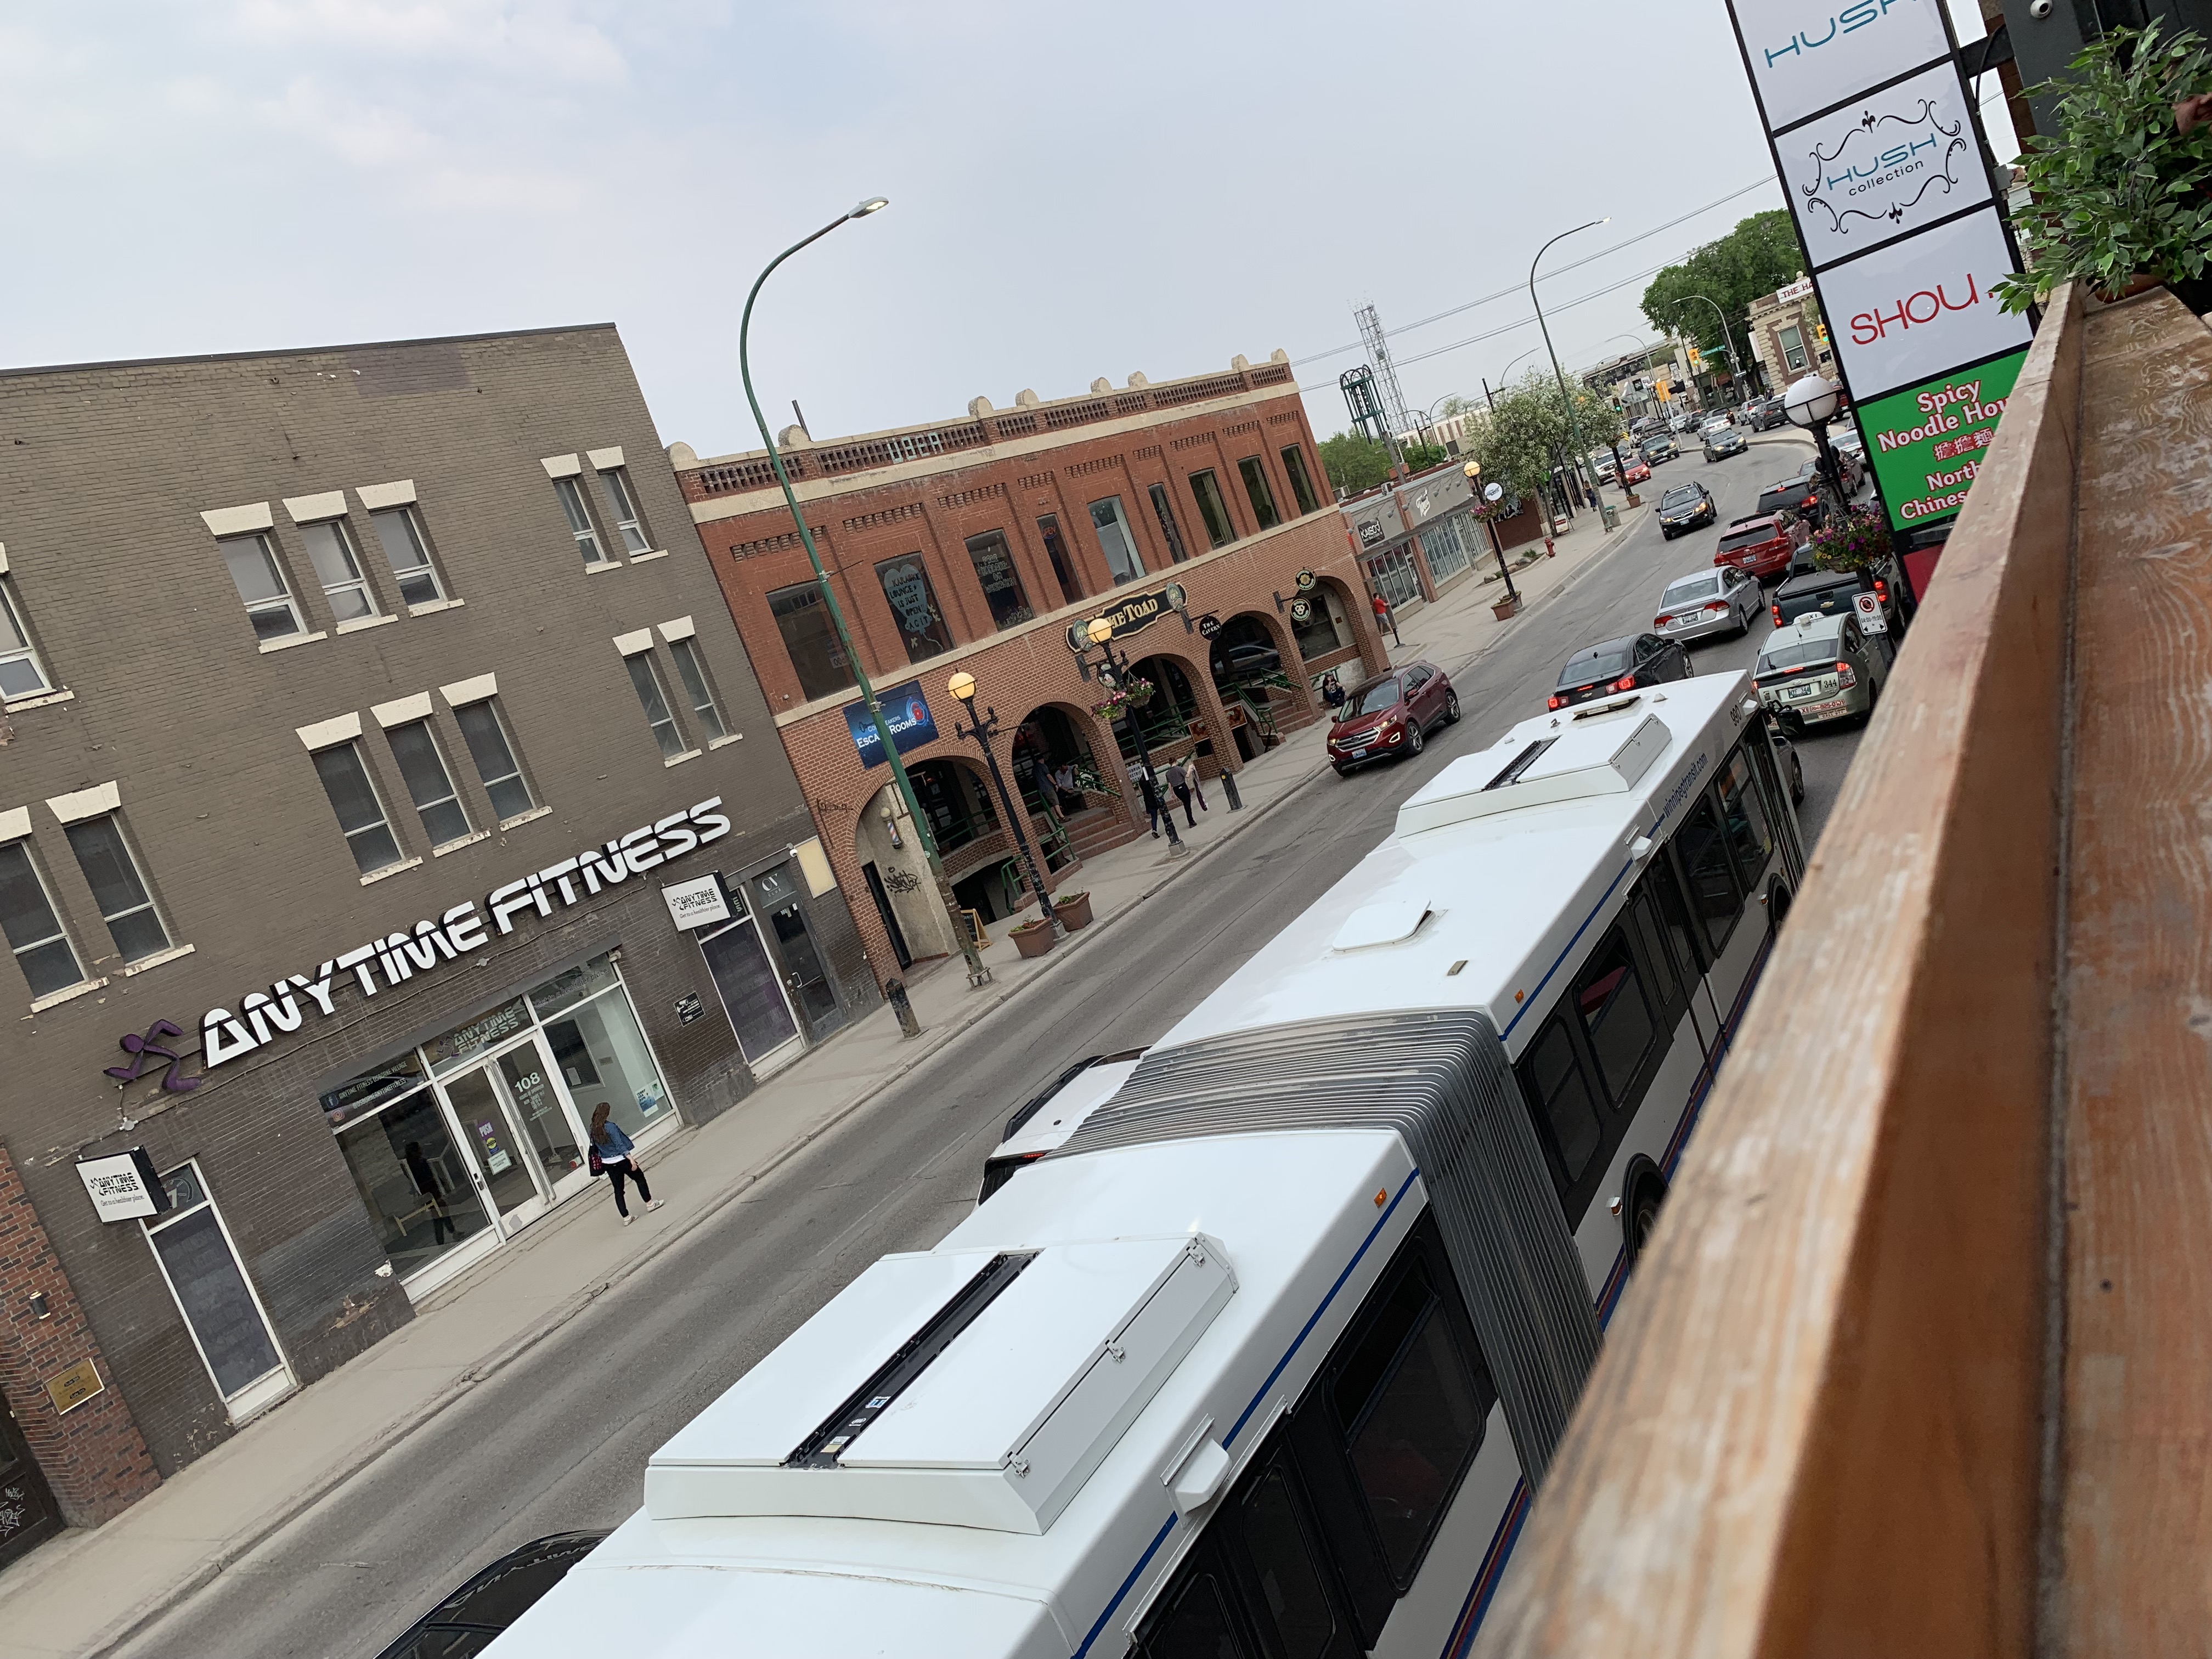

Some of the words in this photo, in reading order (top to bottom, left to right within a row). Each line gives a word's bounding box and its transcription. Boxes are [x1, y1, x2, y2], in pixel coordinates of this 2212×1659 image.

[1826, 133, 1937, 190] HUSH
[1849, 160, 1923, 196] collection
[1782, 286, 1799, 297] THE
[1850, 273, 1994, 345] SHOU
[1916, 380, 1981, 413] Spicy
[1876, 413, 1960, 453] Noodle
[1961, 396, 2009, 425] Hou
[1899, 487, 1970, 520] Chines
[891, 573, 921, 587] KARAOKE
[889, 585, 913, 599] LOUNGE
[906, 594, 919, 606] JUST
[1105, 612, 1126, 629] HE
[1203, 620, 1214, 629] THE
[1202, 624, 1221, 636] CAVERN
[1824, 679, 1837, 688] 344
[1730, 705, 1742, 727] 990
[856, 734, 881, 748] ESCA
[889, 718, 917, 735] ROOMS
[1663, 753, 1708, 818] winnipegtransit.com
[680, 887, 715, 905] ANYTIME
[768, 888, 781, 897] CLUB
[682, 894, 717, 911] FITNESS
[692, 905, 709, 915] healthier
[203, 900, 488, 1068] ANYTIME
[490, 796, 731, 935] FITNESS
[534, 996, 548, 1008] Get
[546, 992, 556, 1003] to
[554, 991, 562, 999] a
[558, 974, 590, 995] healthier
[454, 1006, 516, 1046] ANYTIME
[458, 1017, 520, 1054] FITNESS
[338, 1086, 357, 1099] ANYTIME
[356, 1077, 373, 1090] FITNESS
[371, 1068, 392, 1082] OSBORNE
[391, 1060, 408, 1073] VILLAGE
[515, 1072, 540, 1093] 108
[478, 1122, 494, 1137] PUSH
[98, 1171, 134, 1188] ANYTIME
[103, 1181, 139, 1197] FITNESS
[114, 1194, 132, 1204] healthier
